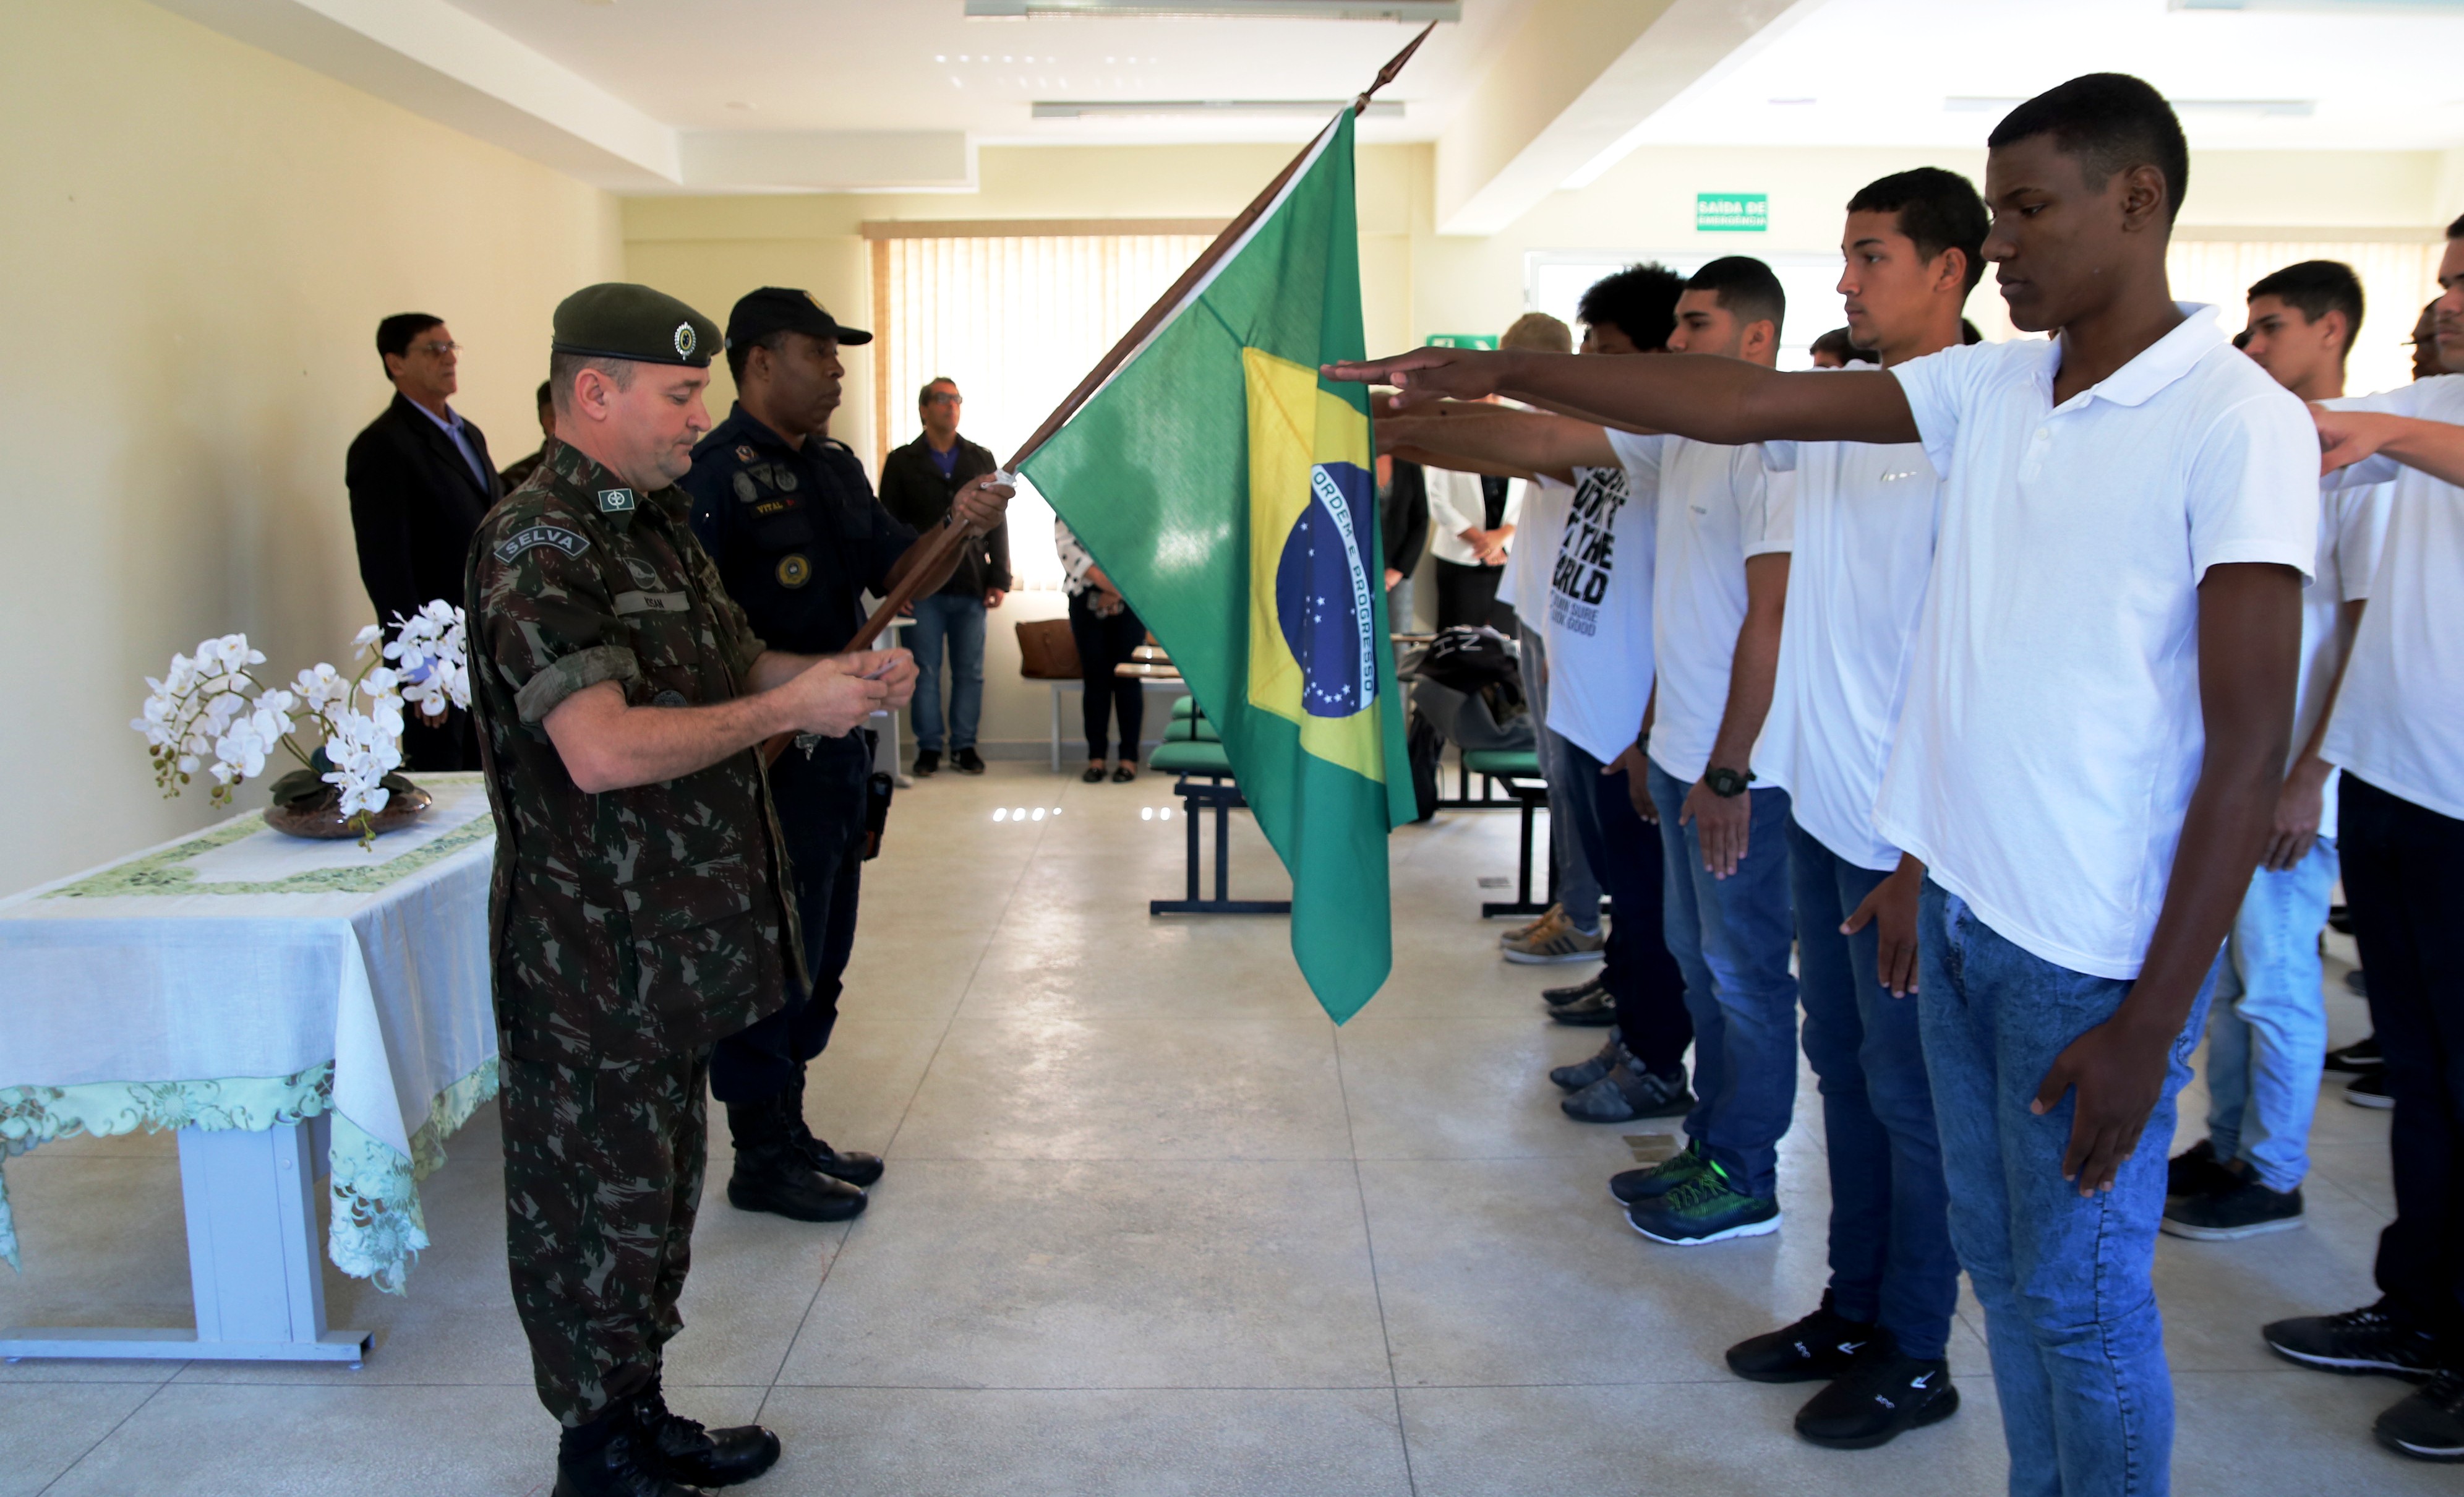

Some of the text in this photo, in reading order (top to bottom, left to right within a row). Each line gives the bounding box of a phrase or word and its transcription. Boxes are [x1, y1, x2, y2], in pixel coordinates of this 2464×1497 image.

[1745, 200, 1766, 215] DE
[756, 502, 784, 513] VITAL
[505, 529, 573, 555] SELVA
[1314, 471, 1373, 692] ORDEM E PROGRESSO
